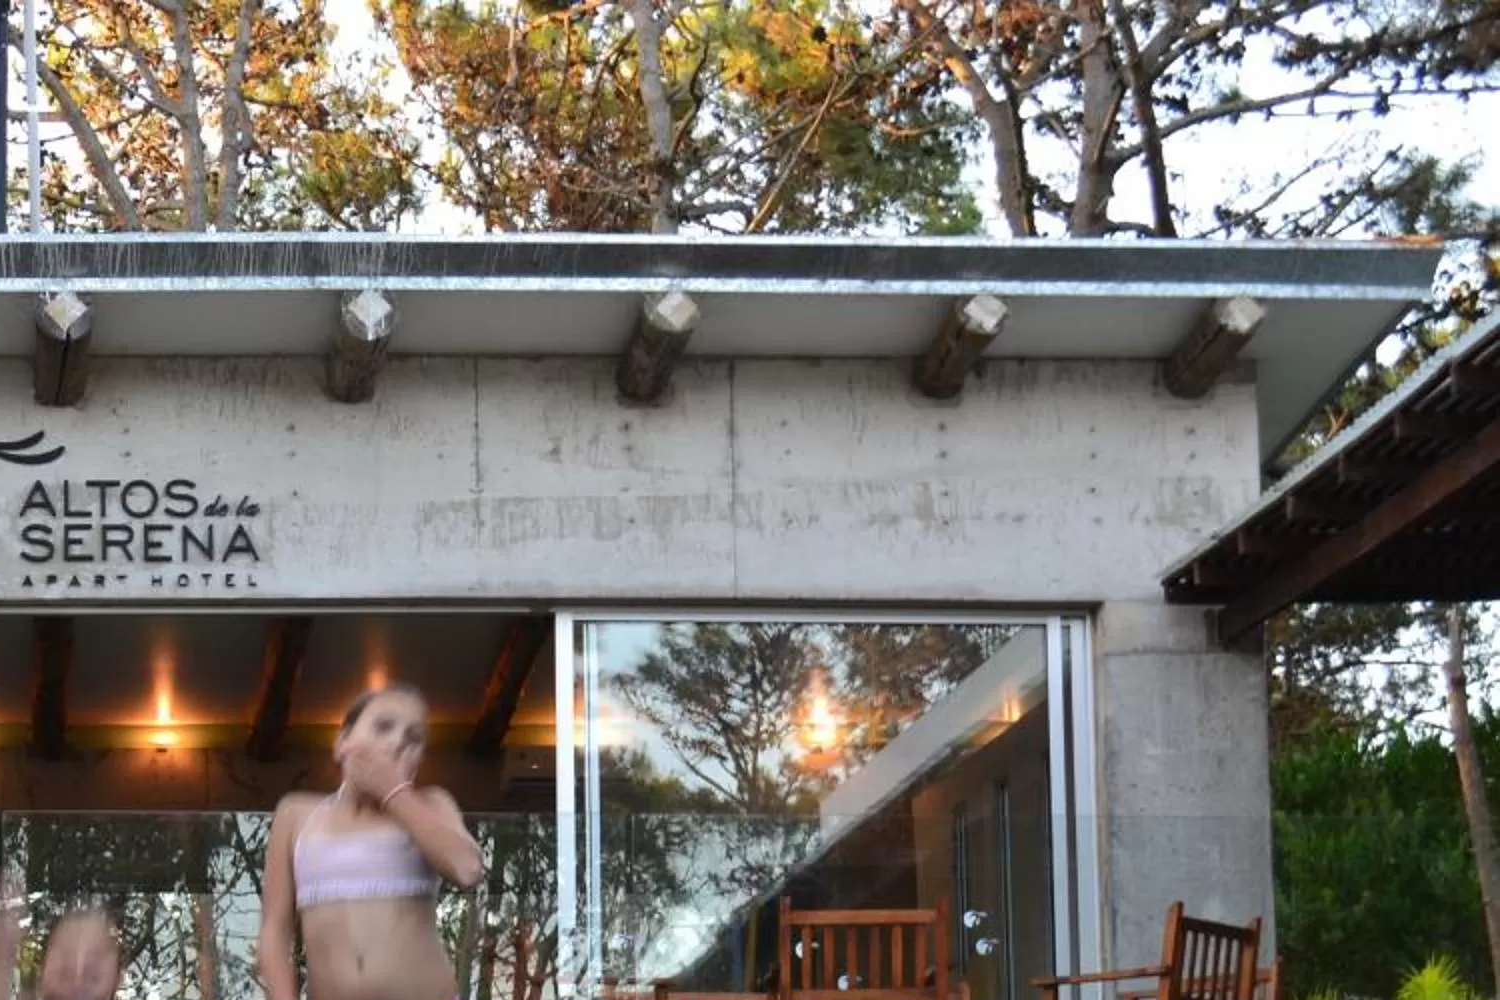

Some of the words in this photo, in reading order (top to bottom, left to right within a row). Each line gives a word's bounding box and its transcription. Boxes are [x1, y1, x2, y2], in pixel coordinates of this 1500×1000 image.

[19, 479, 199, 519] ALTOS
[203, 494, 229, 517] de
[236, 494, 261, 517] la
[19, 523, 261, 563] SERENA
[21, 574, 128, 588] APART
[151, 573, 258, 588] HOTEL
